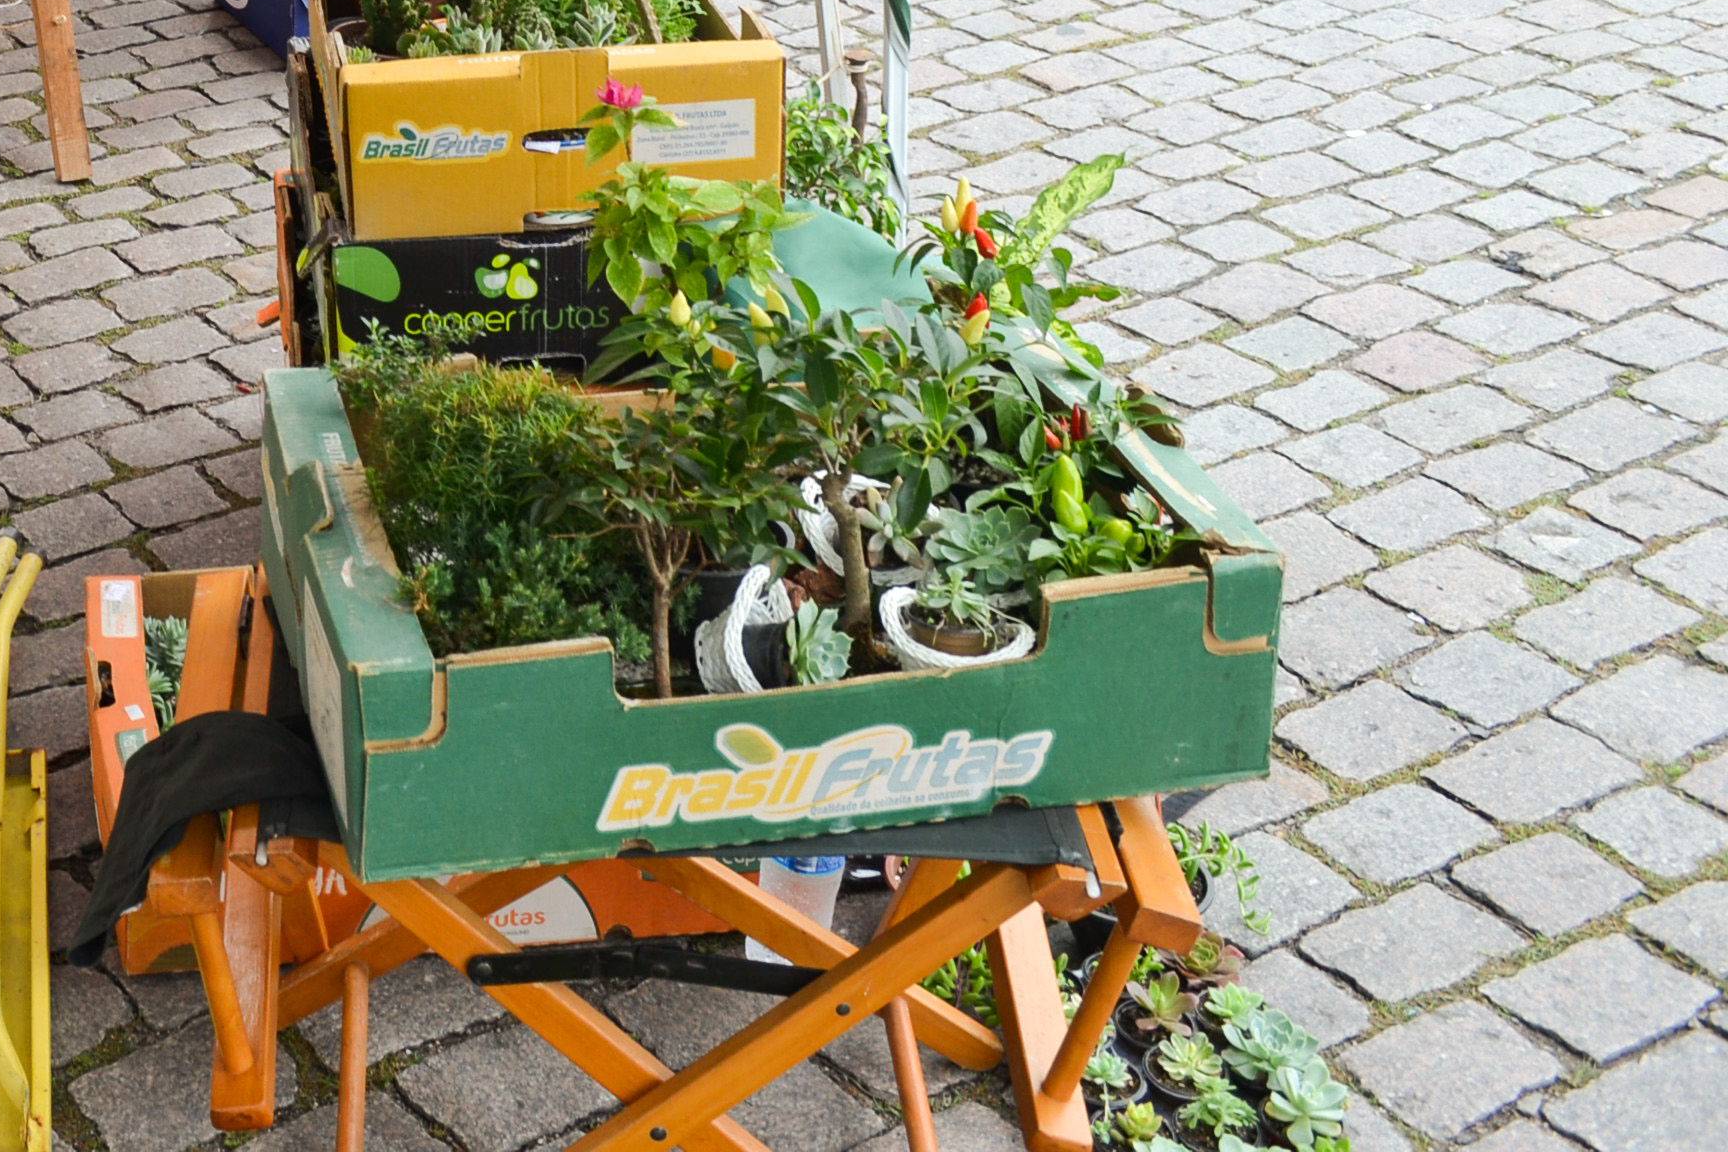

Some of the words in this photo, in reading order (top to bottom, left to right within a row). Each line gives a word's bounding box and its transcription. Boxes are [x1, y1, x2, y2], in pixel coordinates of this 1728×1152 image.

[363, 135, 430, 160] Brasil
[431, 135, 507, 156] Frutas
[606, 746, 820, 823] Brasil
[812, 734, 1046, 803] Frutas
[860, 799, 872, 809] da
[914, 794, 926, 803] ao
